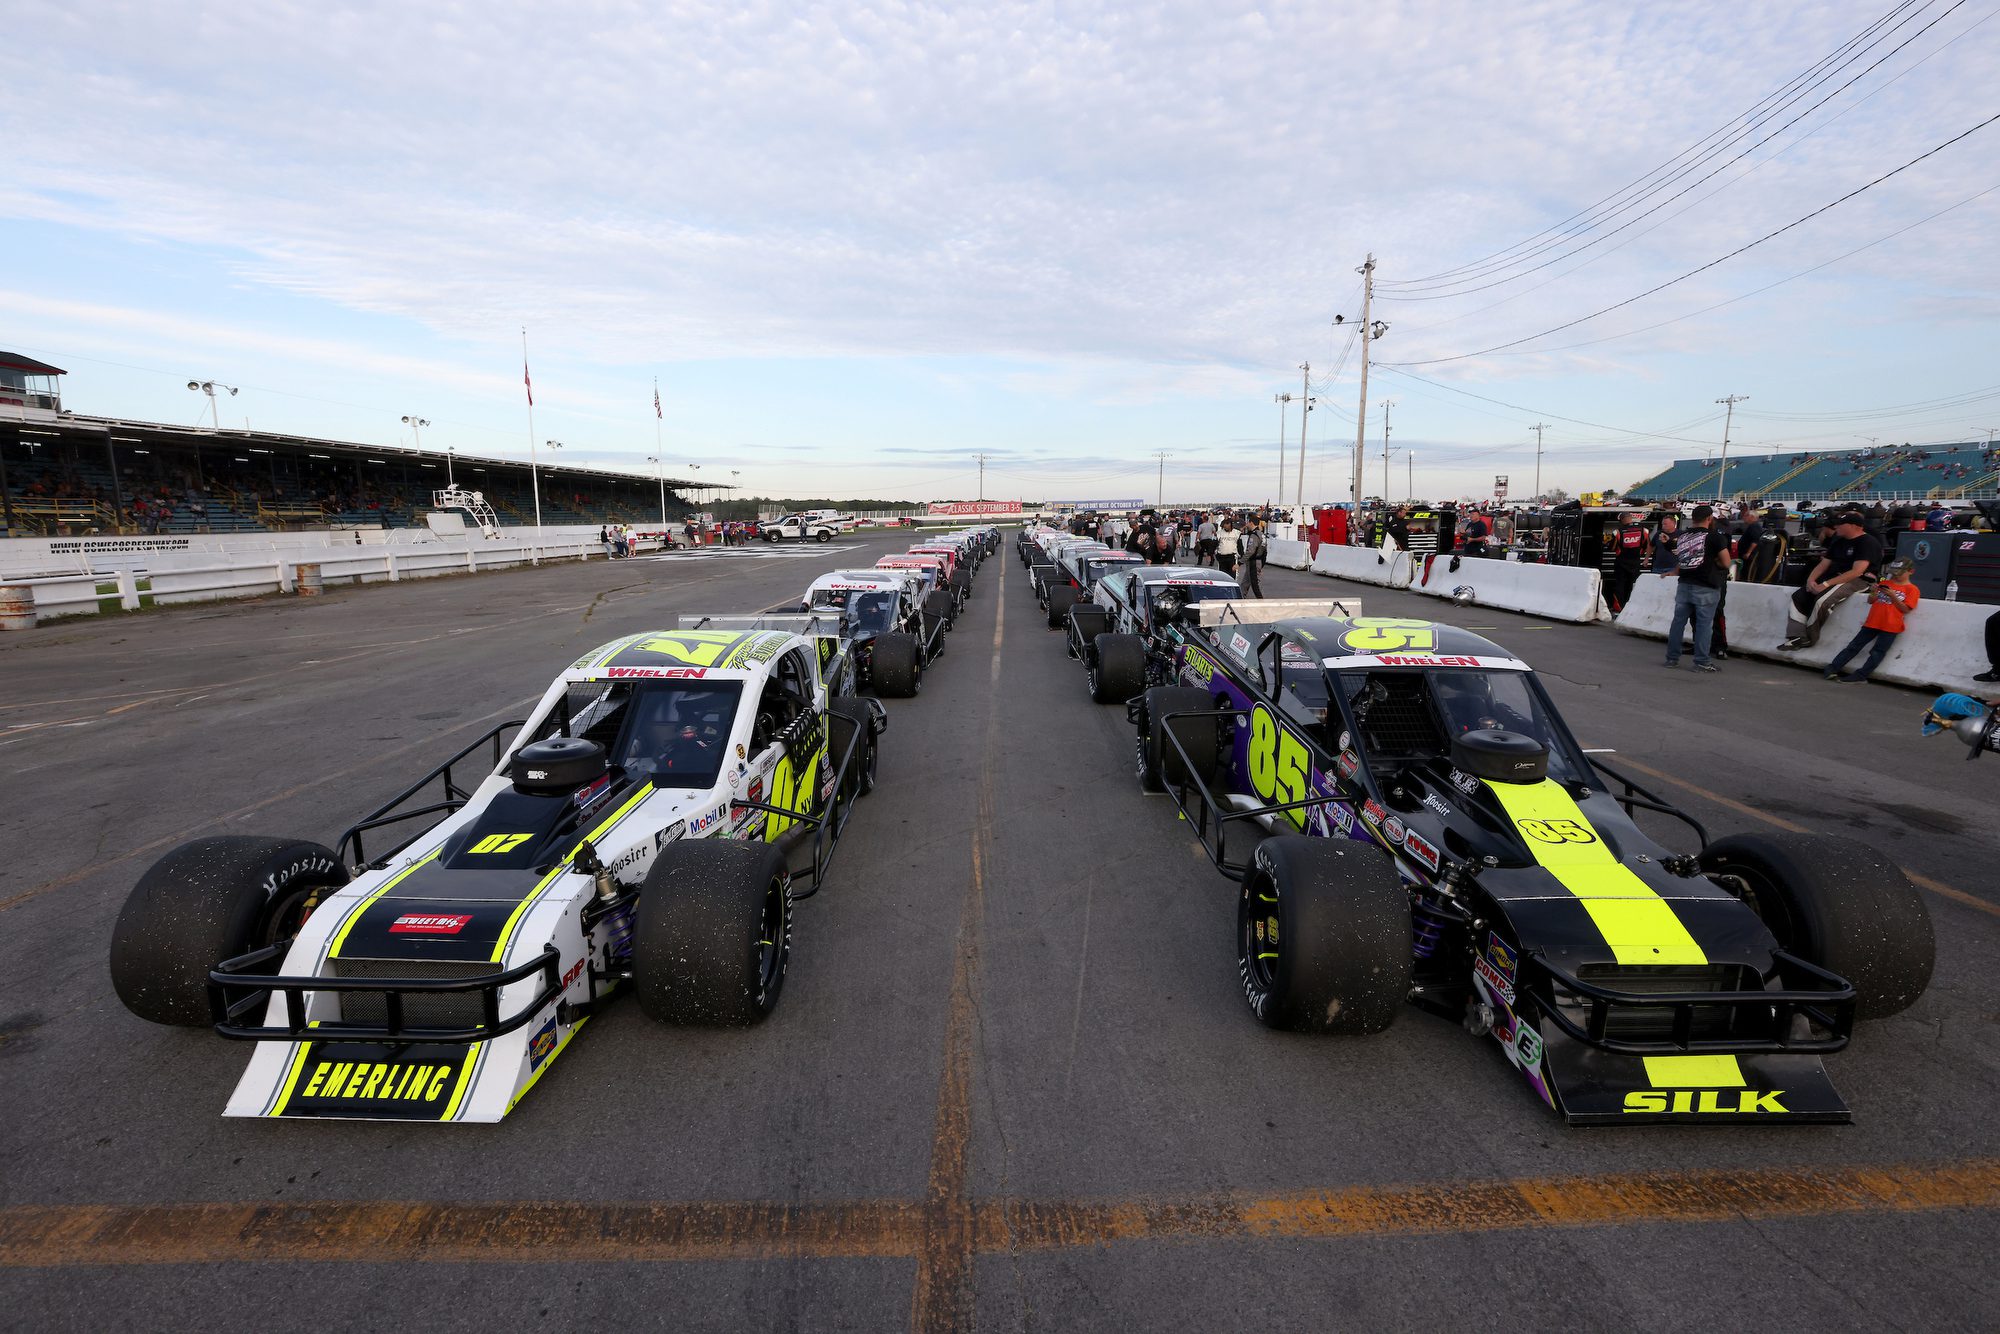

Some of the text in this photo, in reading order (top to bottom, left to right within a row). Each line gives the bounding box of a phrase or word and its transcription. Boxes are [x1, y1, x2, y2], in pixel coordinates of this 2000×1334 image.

[951, 504, 975, 514] CLASSIC
[976, 503, 1010, 513] SEPTEMBER
[1959, 541, 1976, 550] 22
[608, 667, 708, 679] WHELEN
[1376, 656, 1479, 667] WHELEN
[1249, 704, 1311, 833] 85
[1362, 807, 1380, 826] MSD
[1364, 797, 1387, 821] Holley
[1423, 793, 1451, 817] Hoosier
[690, 803, 727, 834] Mobil 1
[1517, 818, 1597, 844] 85
[467, 833, 535, 854] 07
[395, 916, 436, 925] SWEET
[1490, 944, 1515, 971] SUNOCO
[1475, 957, 1506, 990] COMP
[303, 1062, 451, 1102] EMERLING
[1622, 1091, 1790, 1113] SILK
